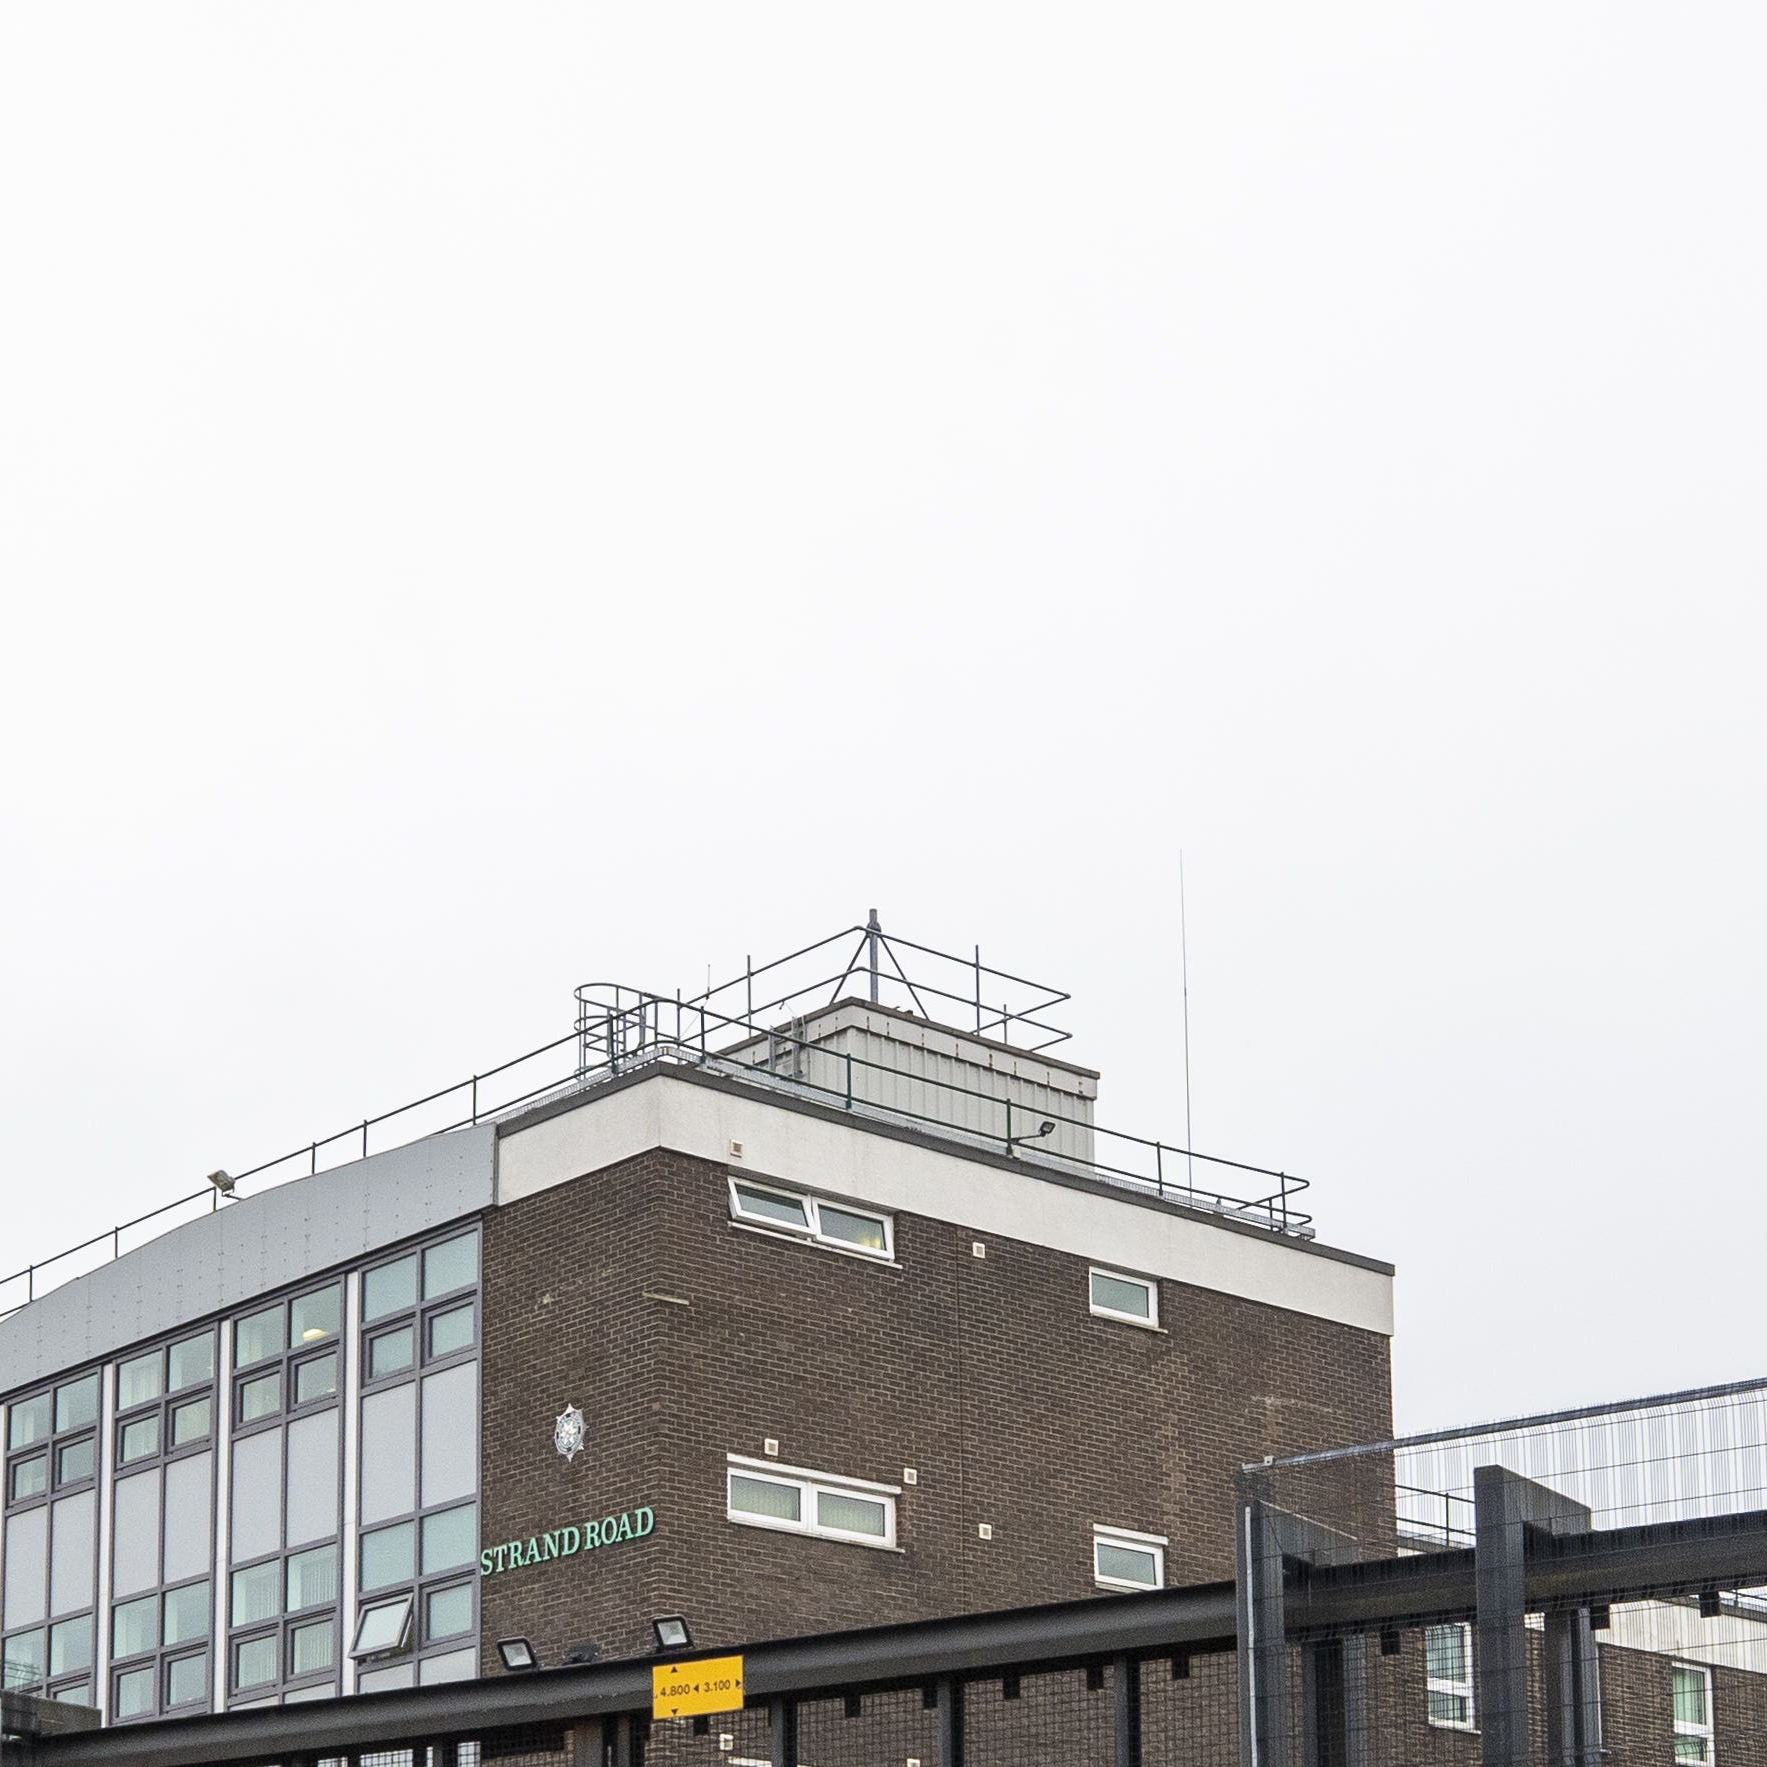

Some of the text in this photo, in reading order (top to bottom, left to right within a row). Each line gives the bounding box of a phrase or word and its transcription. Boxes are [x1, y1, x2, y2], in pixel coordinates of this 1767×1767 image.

[481, 1506, 654, 1576] STRAND ROAD
[660, 1679, 731, 1697] 4.800 3.100
